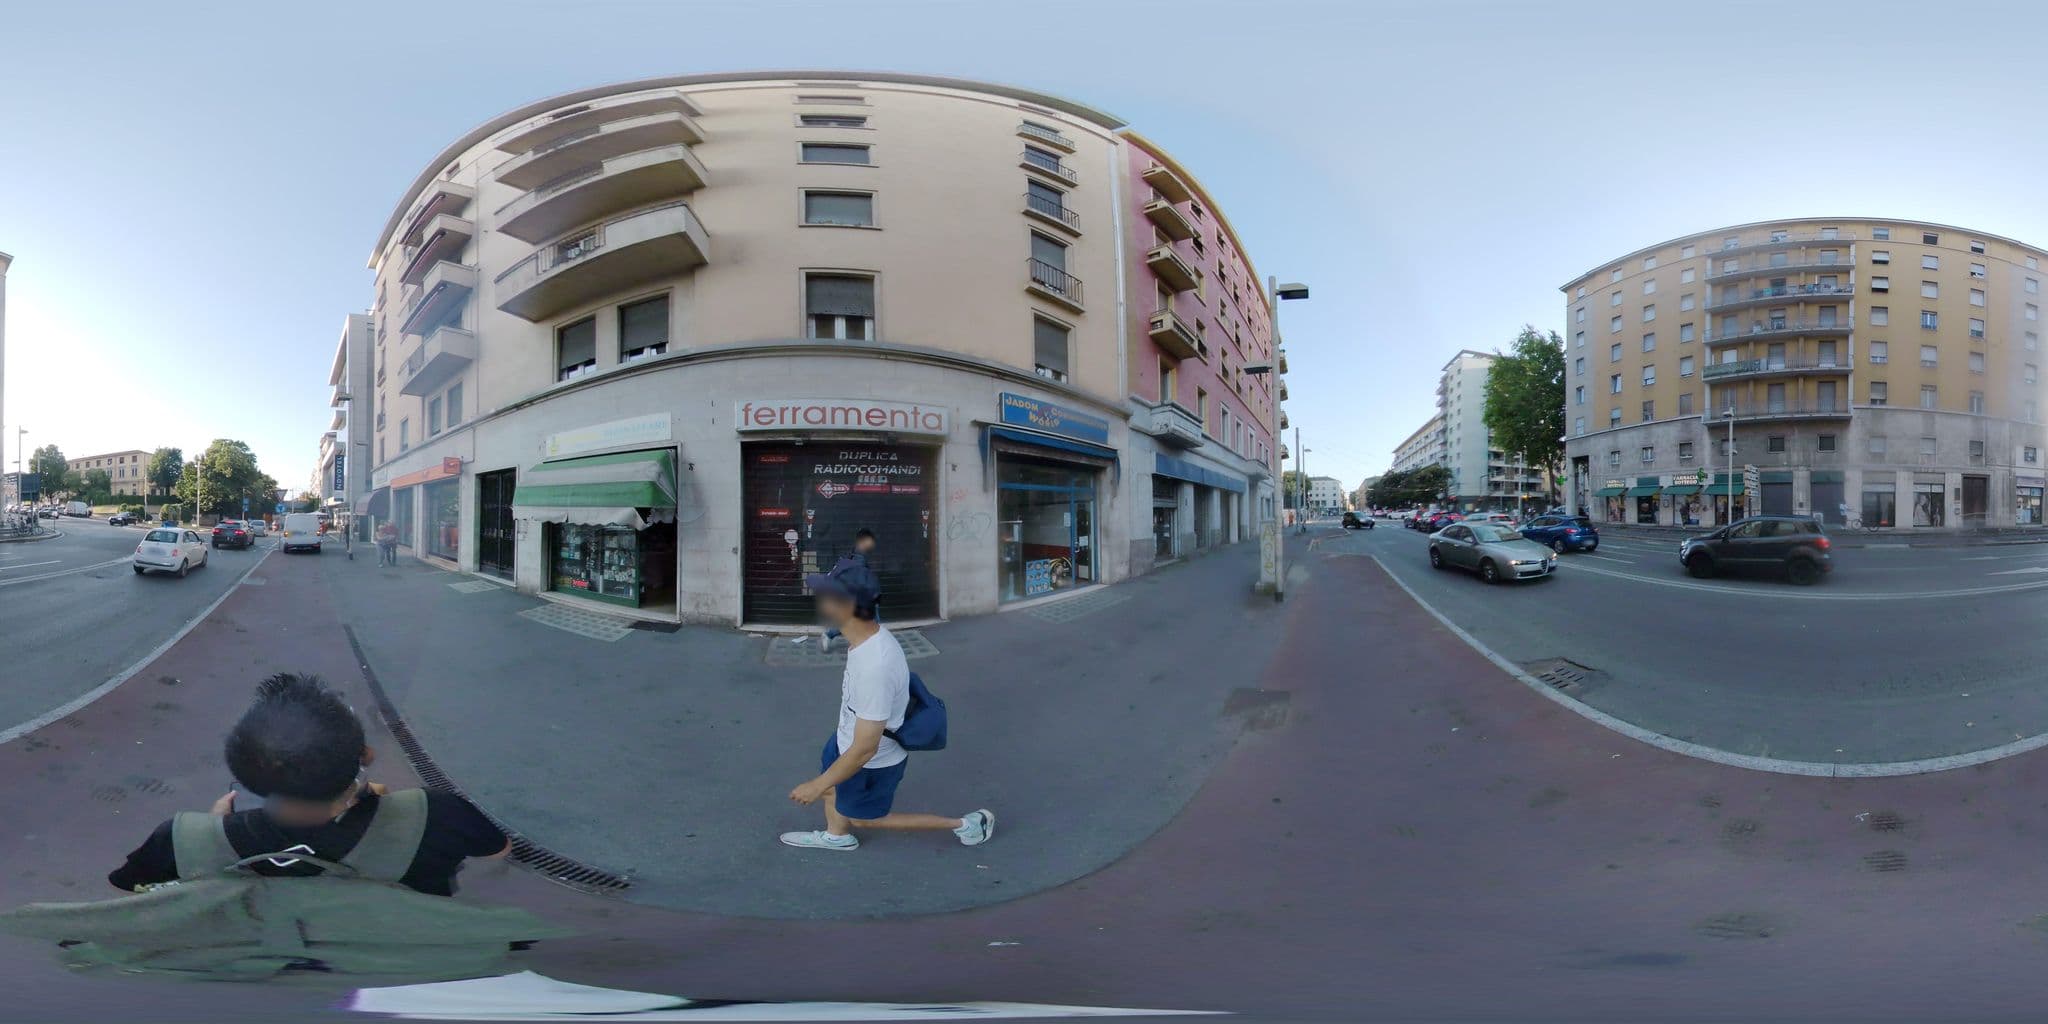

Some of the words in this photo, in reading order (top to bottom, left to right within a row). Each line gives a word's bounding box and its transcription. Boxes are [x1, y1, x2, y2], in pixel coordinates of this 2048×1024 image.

[742, 402, 943, 431] ferramenta
[840, 451, 898, 461] DUPLICA
[814, 464, 921, 475] RADIOCOMANDI
